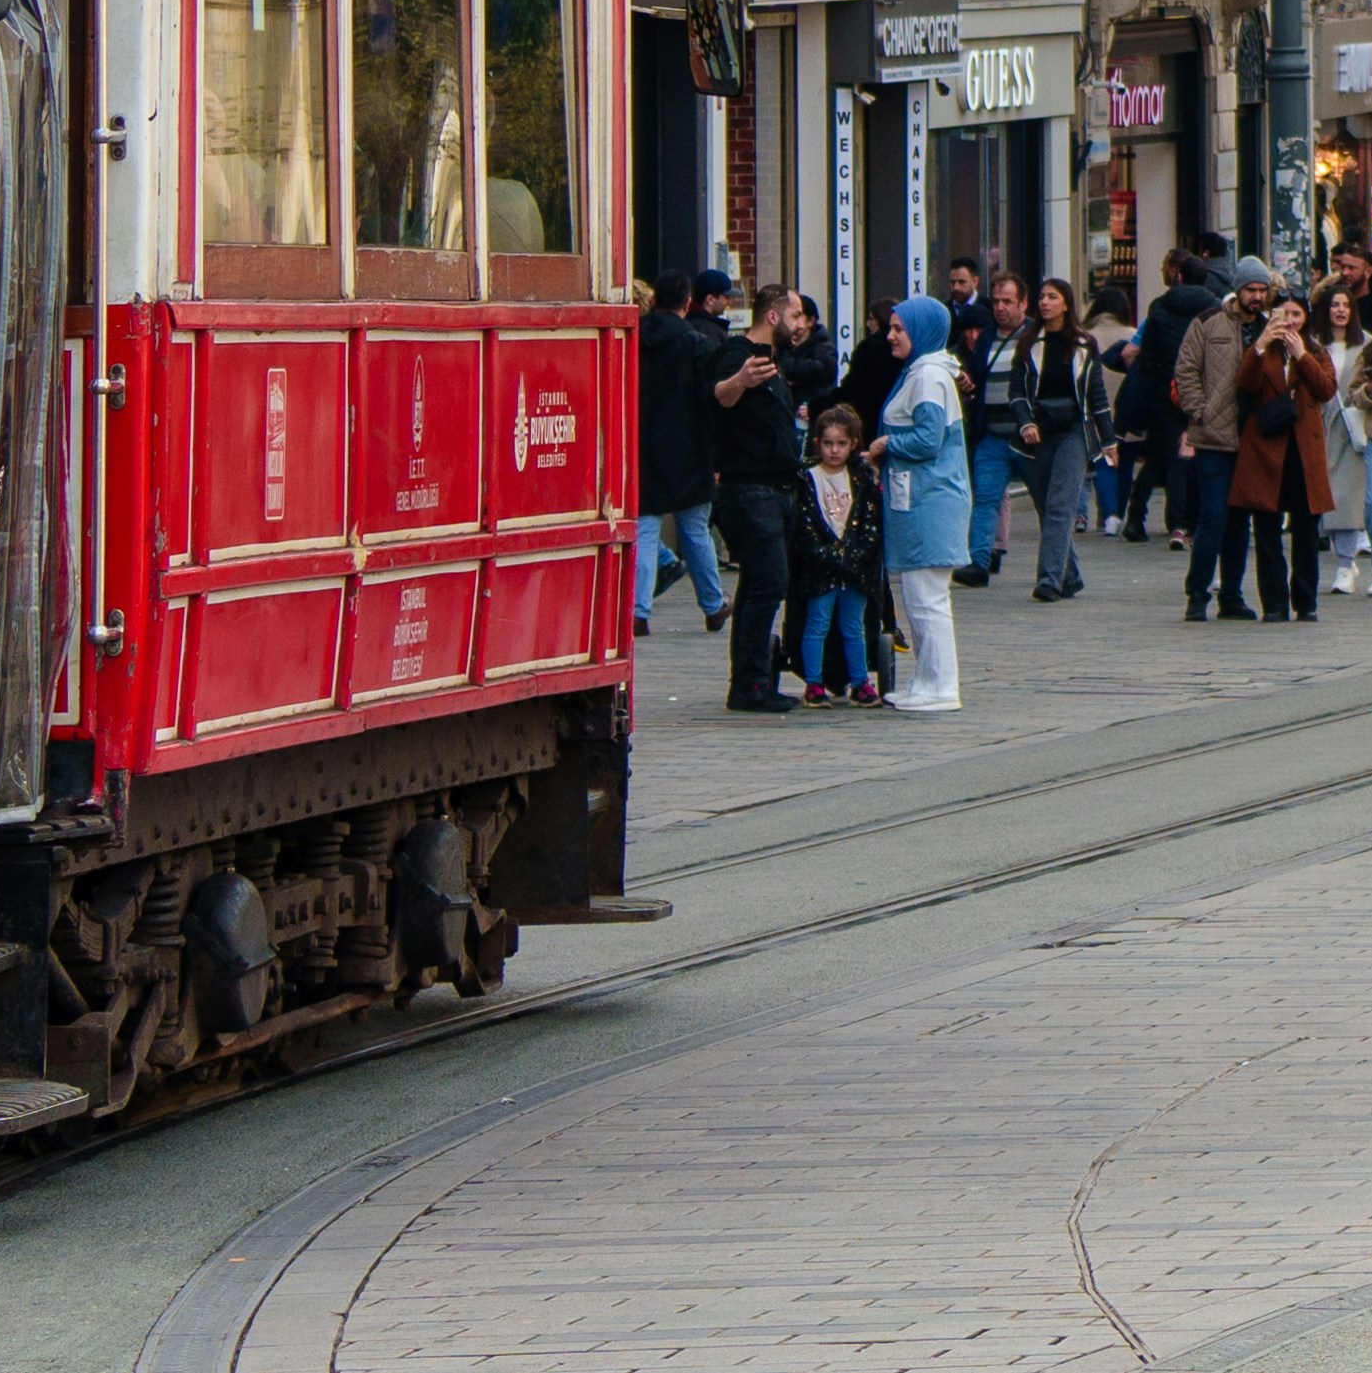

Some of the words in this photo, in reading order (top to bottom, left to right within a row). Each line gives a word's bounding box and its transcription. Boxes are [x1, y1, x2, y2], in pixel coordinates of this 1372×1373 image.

[883, 17, 927, 57] CHANGE
[928, 14, 964, 55] OFFICE
[966, 45, 1035, 112] GUESS
[912, 100, 921, 227] CHANGE
[837, 111, 851, 286] WECHSEL
[530, 406, 576, 453] BÜYÜKŞEHİR
